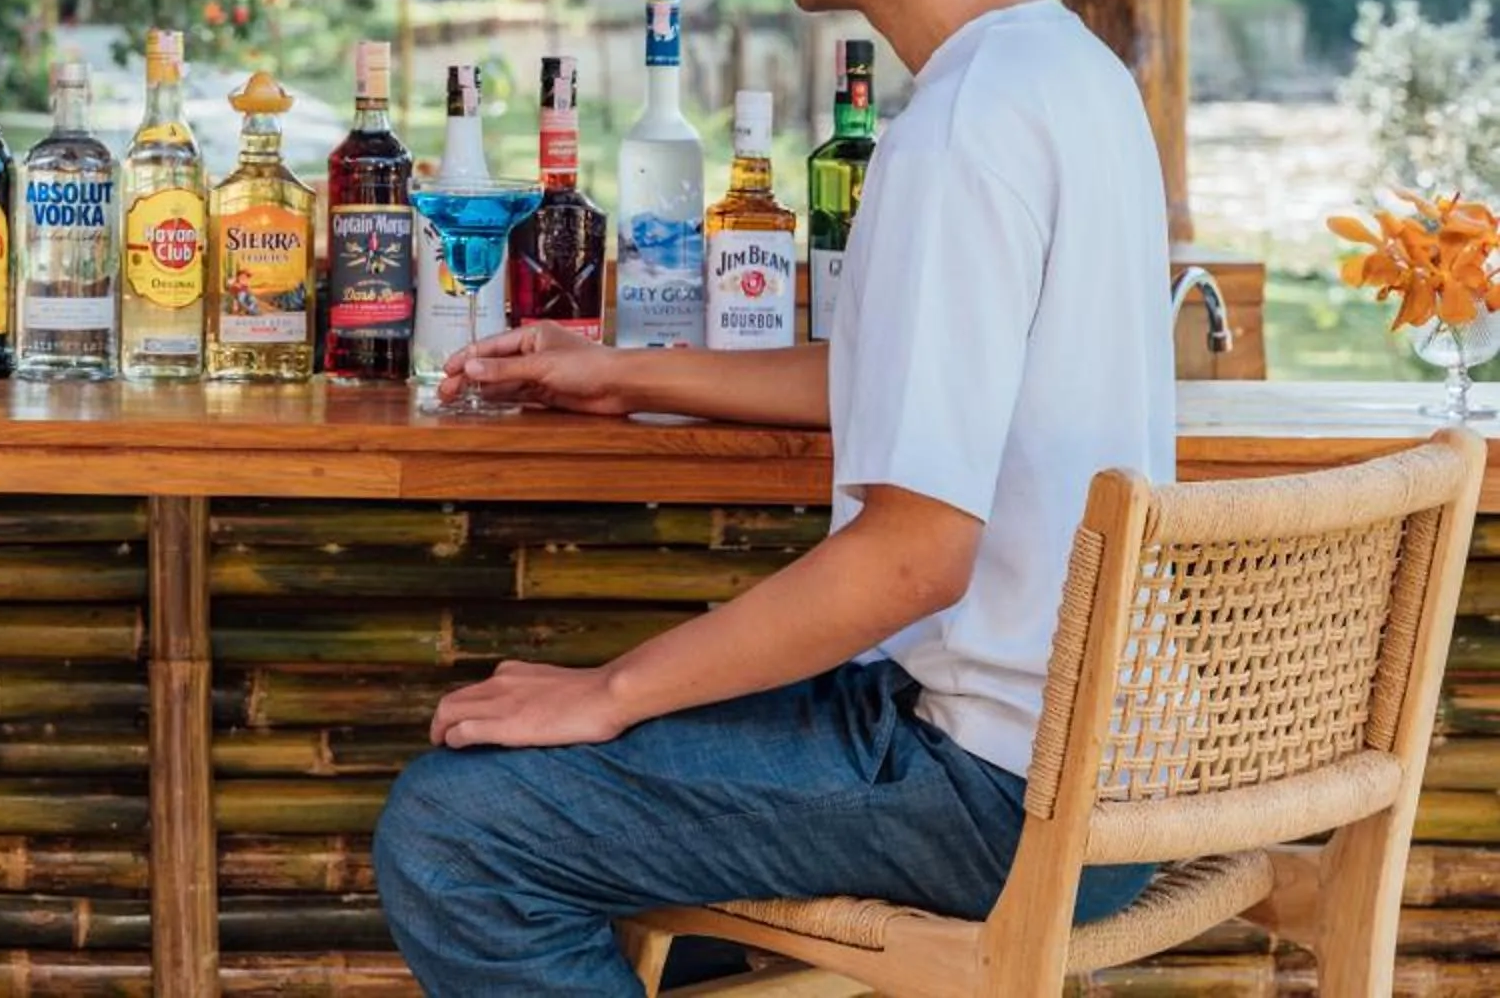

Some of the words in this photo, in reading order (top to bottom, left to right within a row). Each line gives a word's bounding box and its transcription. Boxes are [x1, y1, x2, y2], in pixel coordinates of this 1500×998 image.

[27, 182, 113, 203] ABSOLUT
[34, 205, 104, 226] VODKA
[334, 214, 373, 237] Captain
[145, 227, 198, 243] Havan
[226, 228, 301, 252] SIERRA
[156, 243, 193, 261] Club
[715, 251, 746, 277] JIM
[748, 244, 790, 278] BEAM
[721, 313, 783, 330] BOURBON
